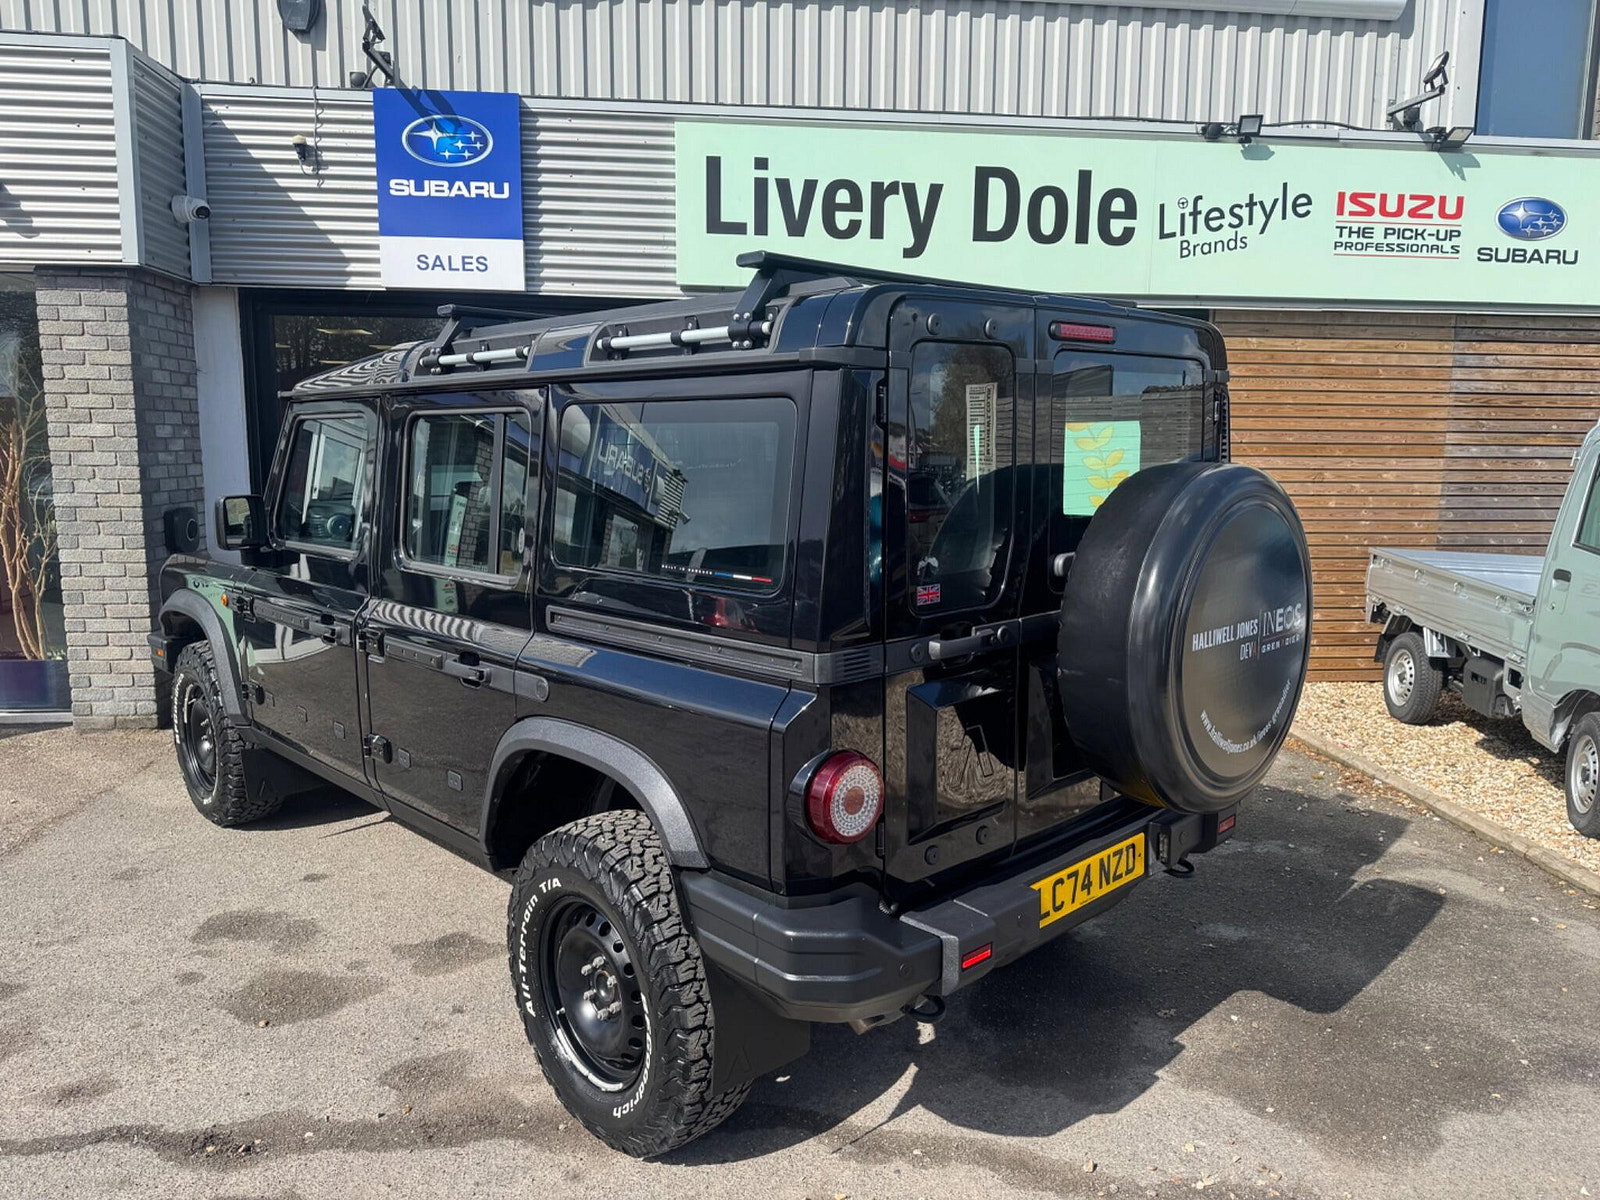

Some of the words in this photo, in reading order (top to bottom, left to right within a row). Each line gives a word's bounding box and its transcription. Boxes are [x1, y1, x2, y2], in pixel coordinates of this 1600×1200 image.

[389, 178, 510, 199] SUBARU
[705, 156, 944, 259] Livery
[971, 165, 1138, 247] Dole
[1158, 182, 1313, 240] Lifestyle
[1336, 191, 1465, 220] ISUZU
[1179, 231, 1248, 259] Brands
[1333, 241, 1461, 255] PROFESSIONALS
[1336, 225, 1375, 239] THE
[1383, 227, 1462, 242] PICK-UP
[416, 253, 489, 273] SALES
[1476, 247, 1579, 265] SUBARU
[1263, 603, 1302, 637] INEOS
[1192, 625, 1235, 652] HALLIWELL
[1236, 618, 1258, 640] JONES
[1099, 843, 1136, 890] NZD
[518, 893, 539, 1018] All-Terrain
[538, 877, 563, 895] T/A
